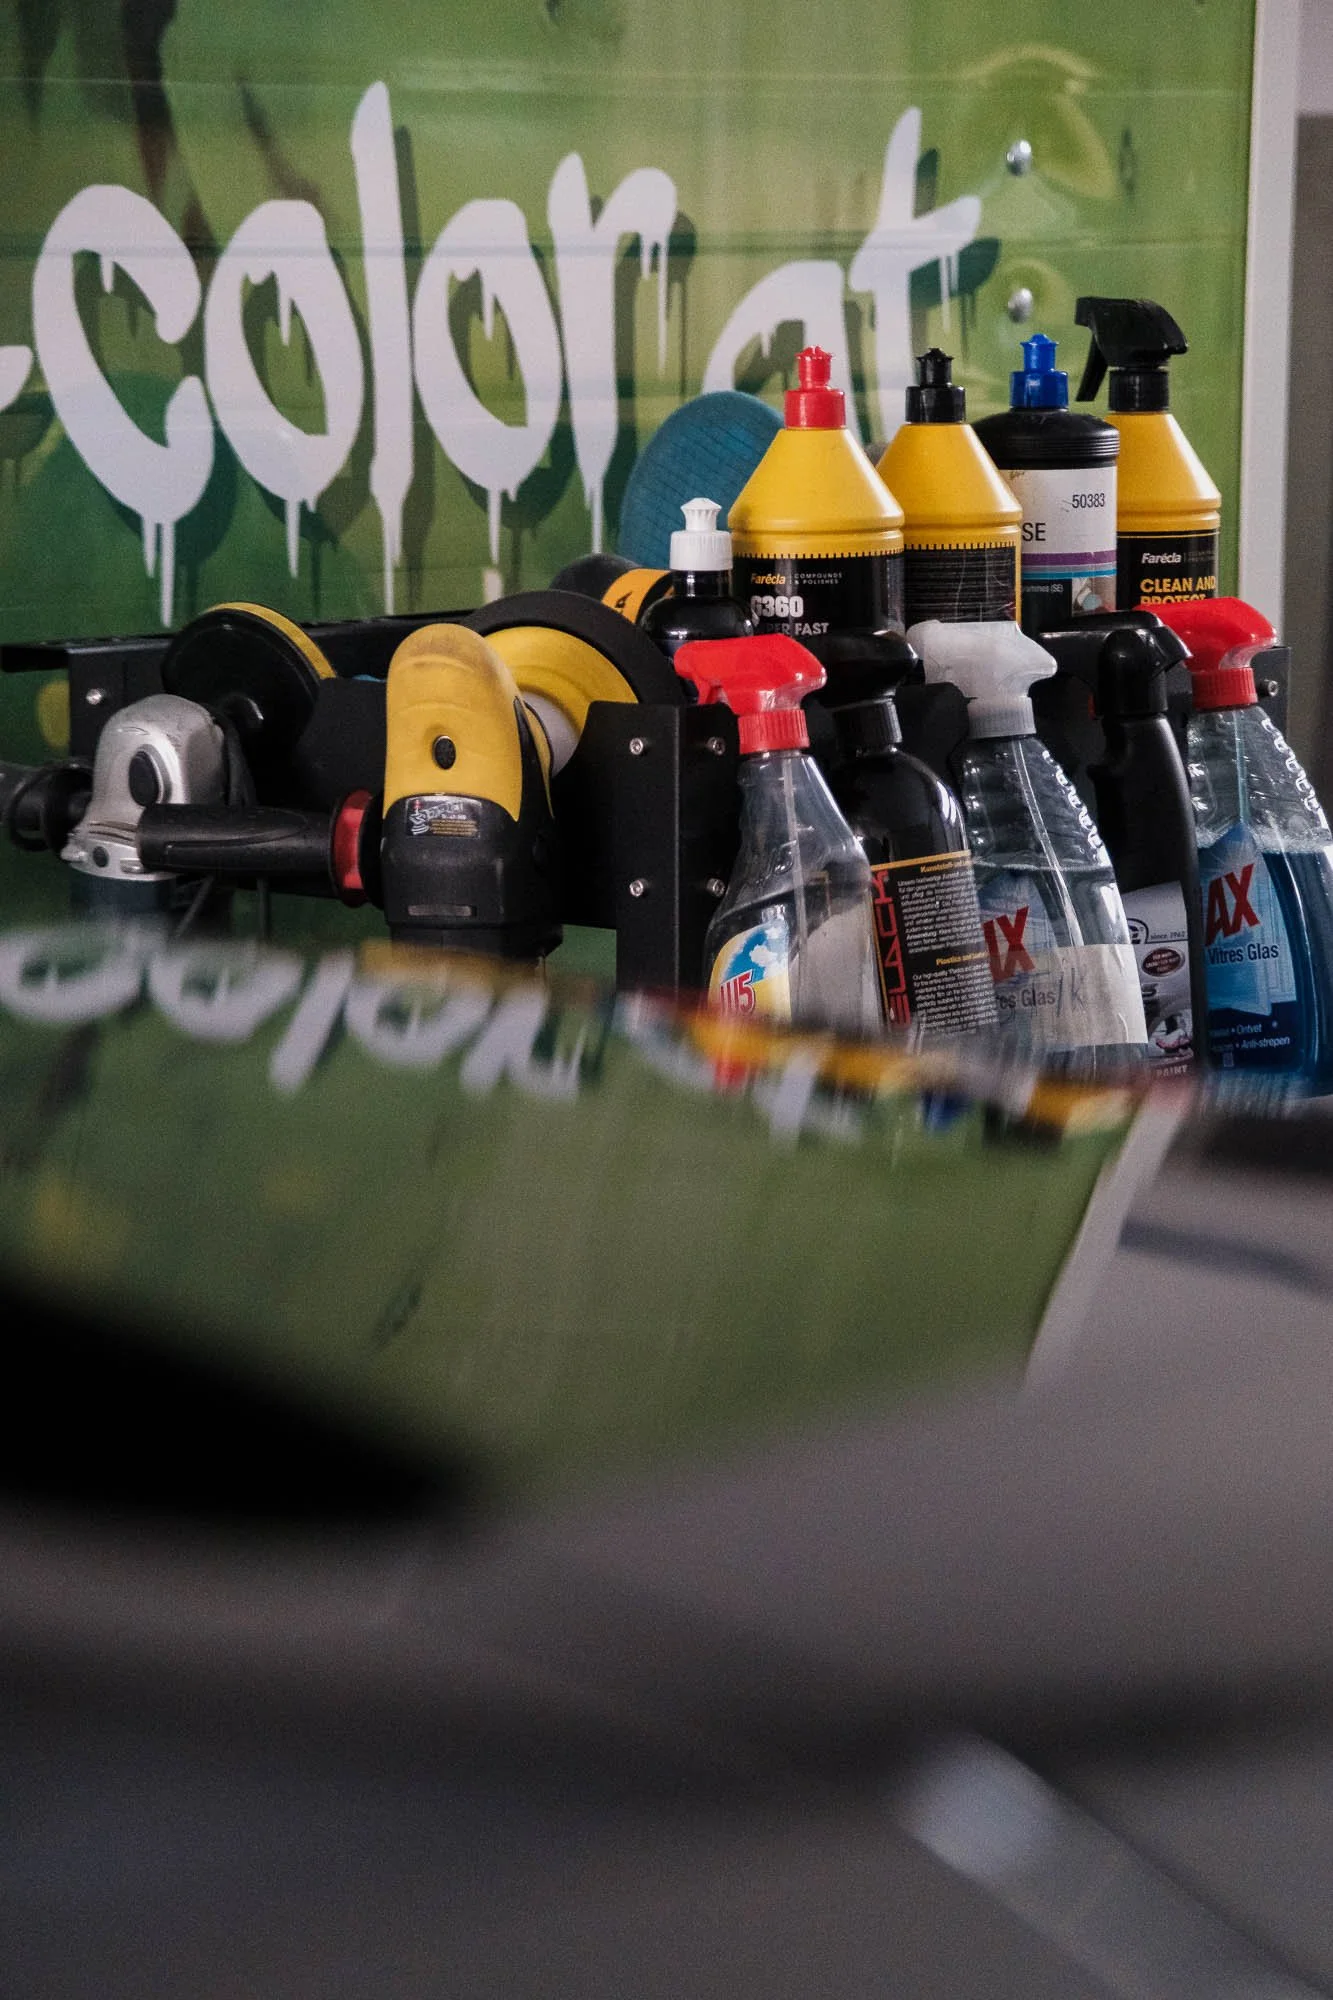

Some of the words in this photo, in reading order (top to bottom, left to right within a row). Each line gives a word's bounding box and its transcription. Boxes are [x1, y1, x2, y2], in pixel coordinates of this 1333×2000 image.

[1072, 493, 1106, 508] 50383
[1022, 522, 1046, 541] SE
[1140, 577, 1194, 593] CLEAN
[1196, 576, 1217, 591] AND
[795, 622, 830, 636] FAST
[1208, 945, 1244, 965] Vitres
[1247, 944, 1279, 961] Glas
[1021, 988, 1056, 1008] Glas
